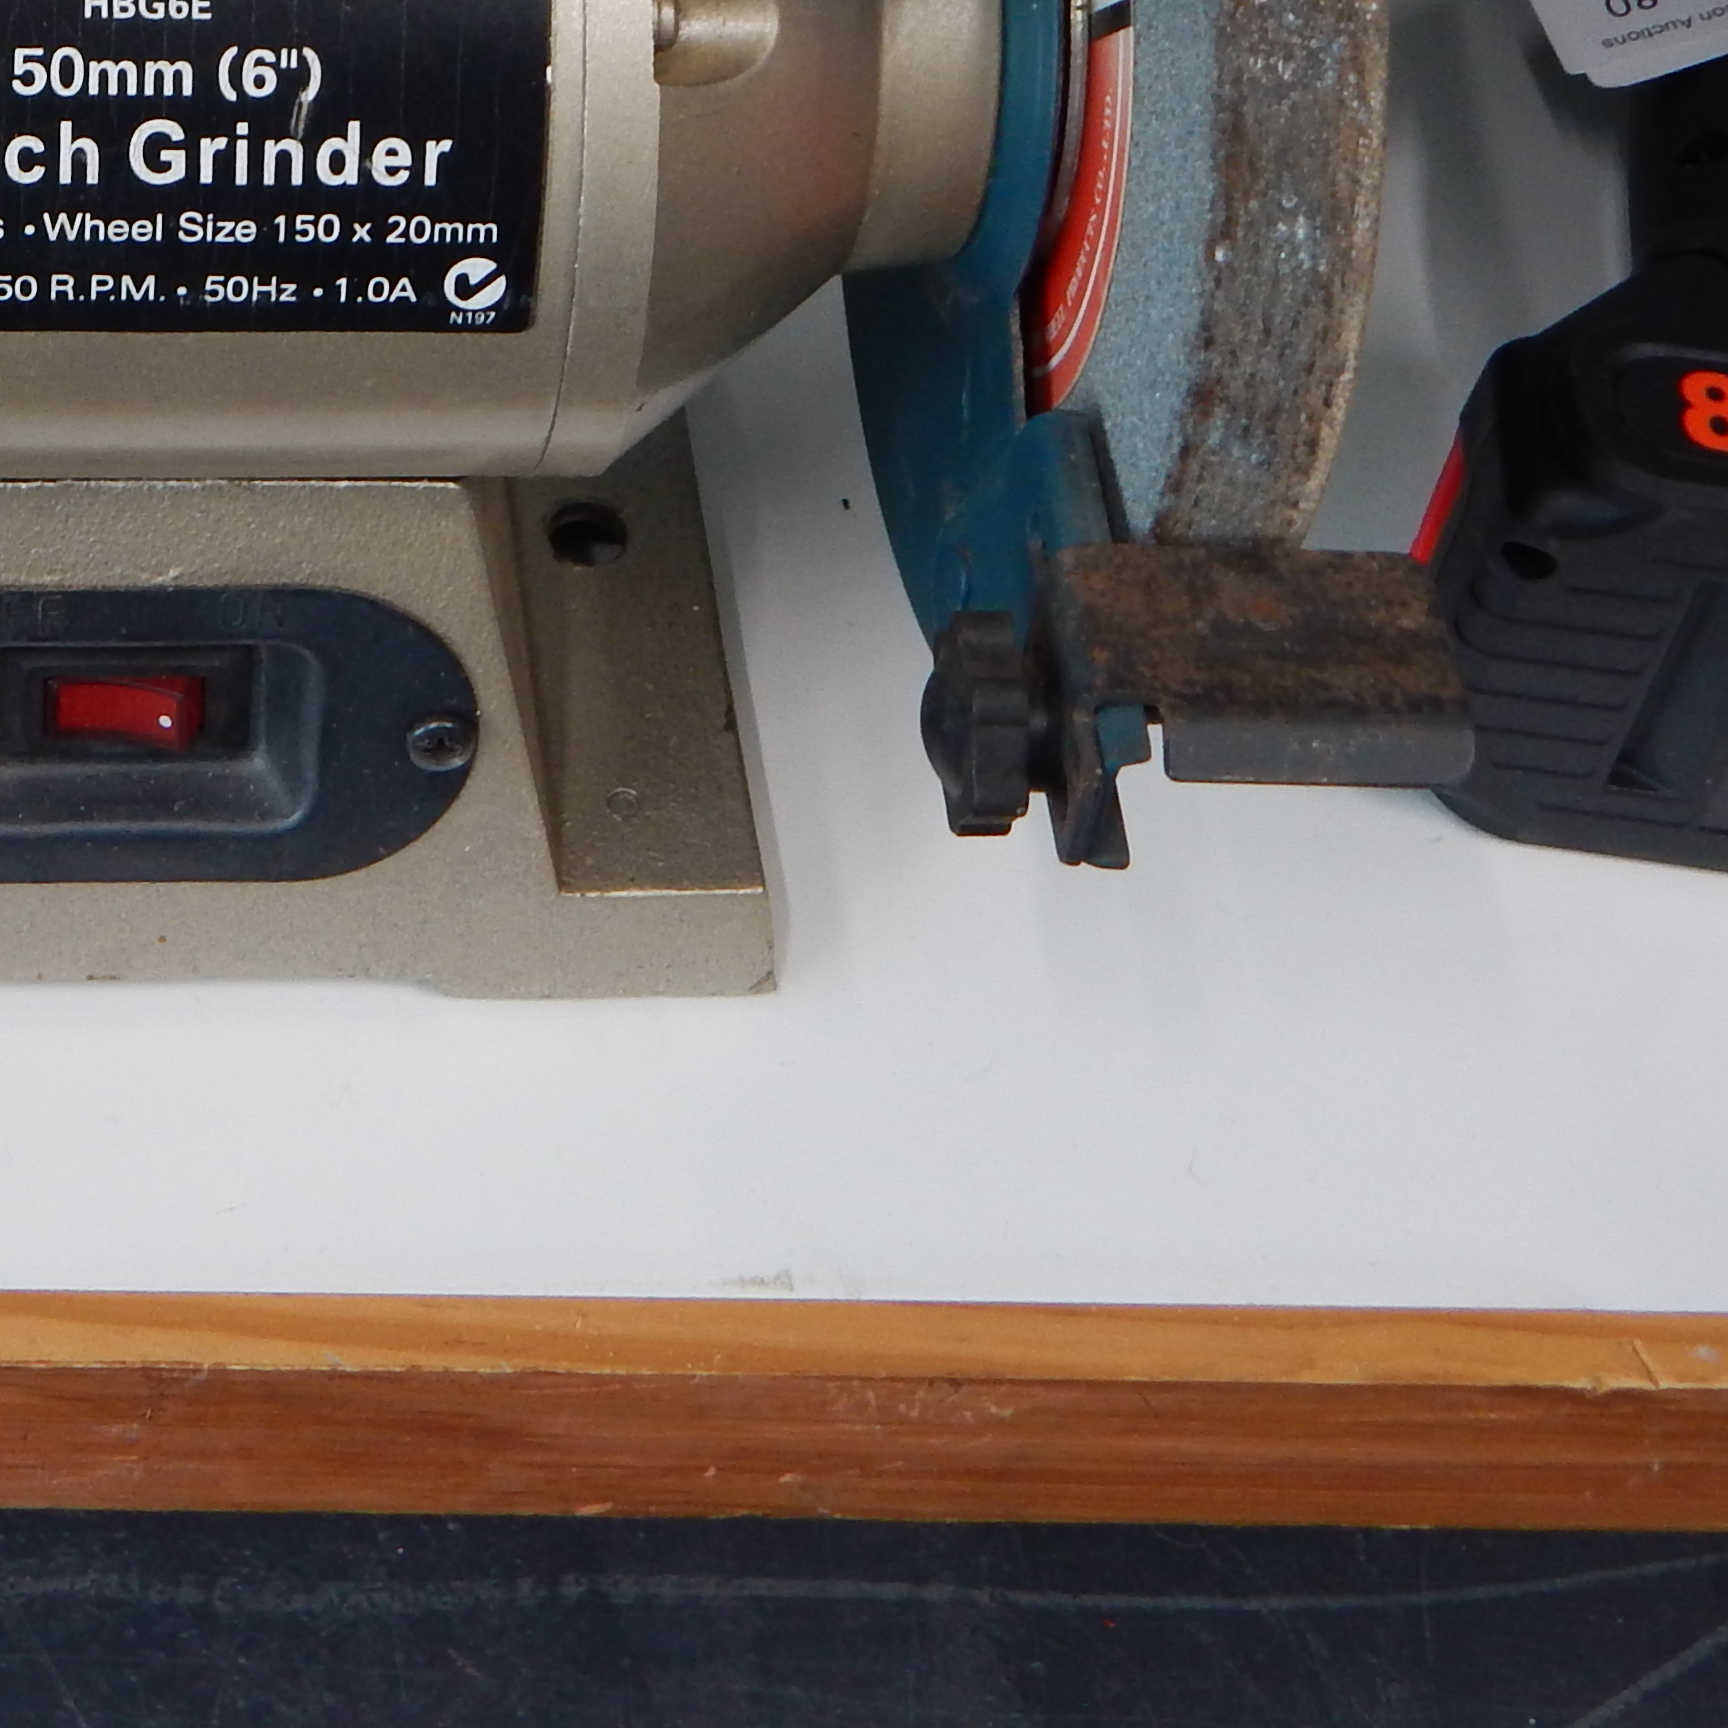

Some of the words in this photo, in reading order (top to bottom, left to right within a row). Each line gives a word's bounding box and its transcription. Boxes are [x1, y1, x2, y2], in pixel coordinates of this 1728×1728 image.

[1600, 15, 1693, 49] Auctions
[218, 45, 323, 102] (6")
[128, 118, 453, 187] Grinder
[42, 212, 163, 242] Wheel
[178, 211, 257, 243] Size
[274, 214, 341, 243] 150
[351, 222, 372, 243] x
[385, 215, 498, 244] 20mm
[50, 274, 165, 302] R.P.M.
[204, 275, 297, 303] 50Hz
[335, 276, 417, 303] 1.0A
[449, 311, 496, 325] N197
[218, 591, 288, 630] ON
